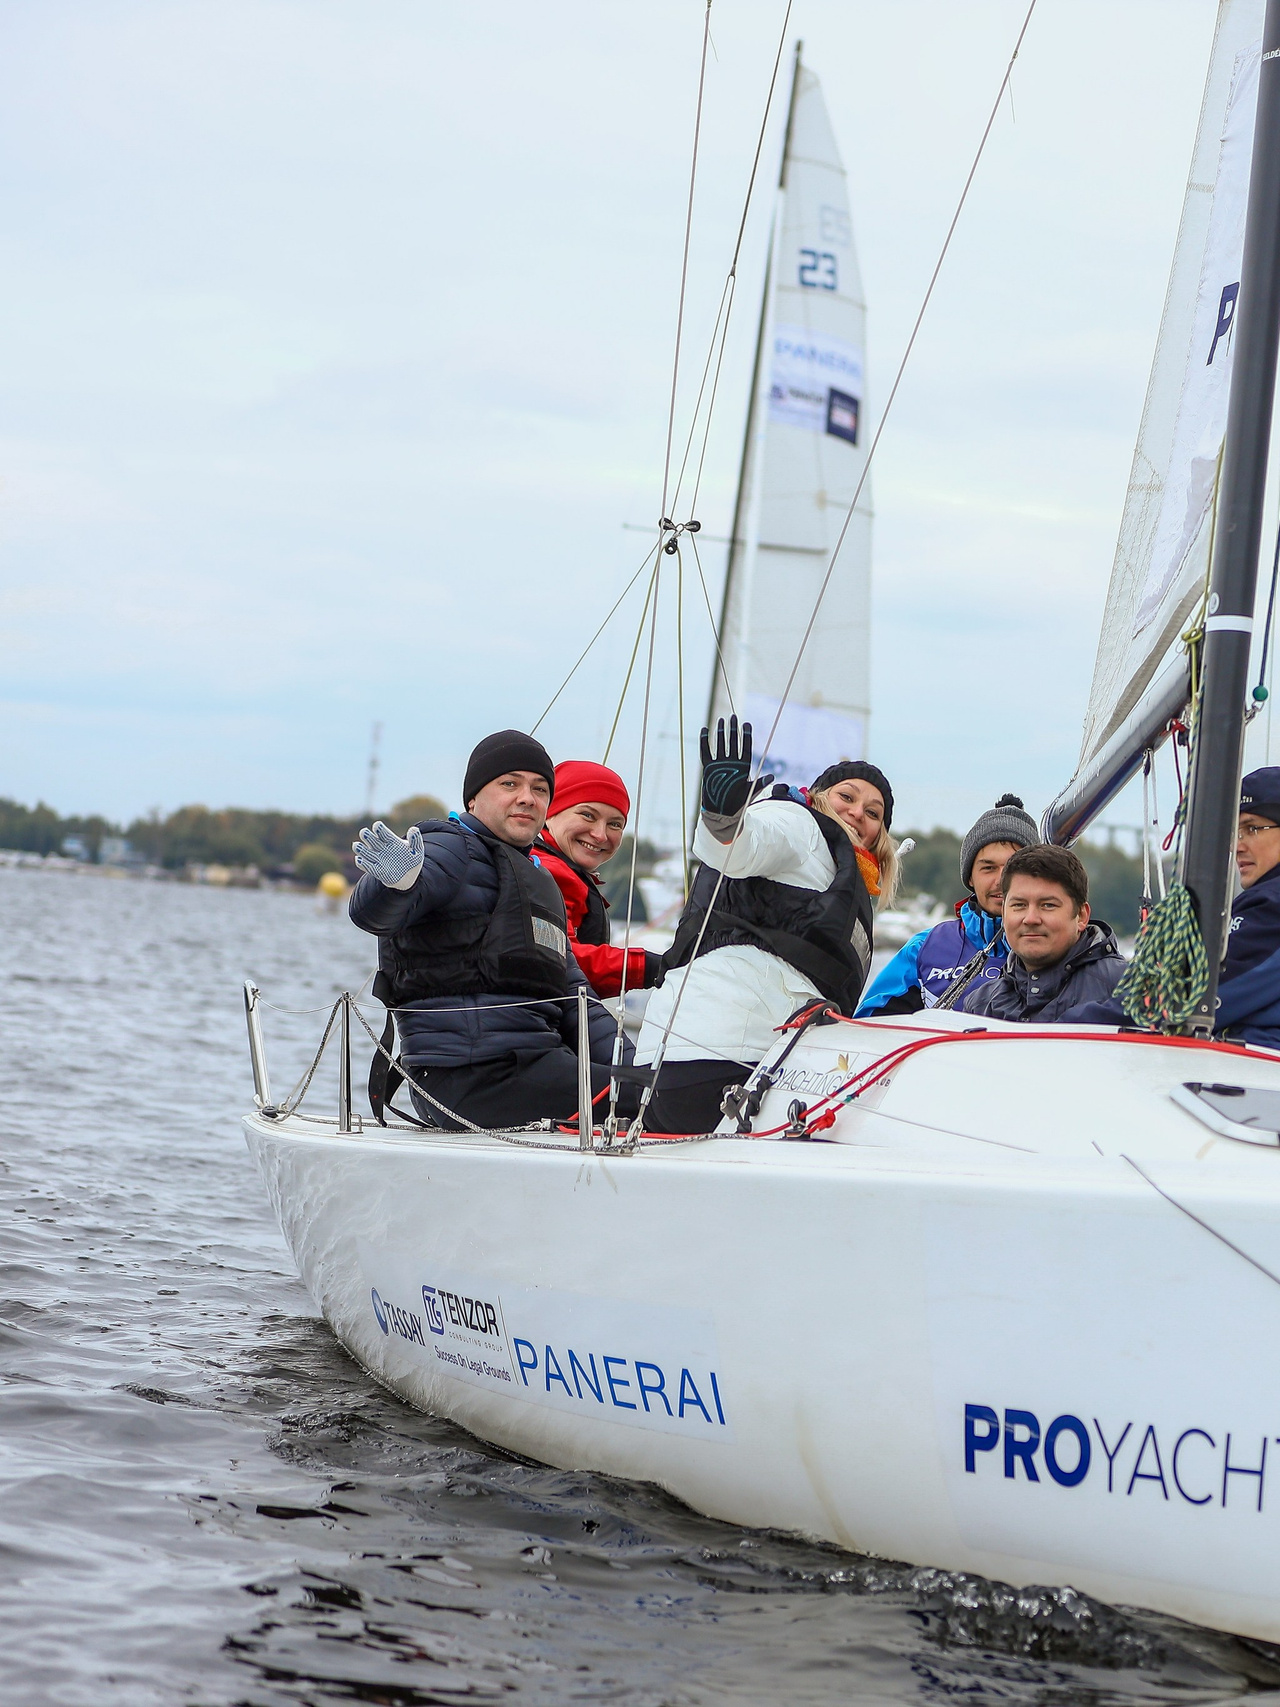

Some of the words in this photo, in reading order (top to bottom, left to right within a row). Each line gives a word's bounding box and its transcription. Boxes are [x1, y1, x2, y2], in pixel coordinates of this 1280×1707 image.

[798, 249, 838, 291] 23
[383, 1300, 426, 1347] TASSAY
[438, 1289, 500, 1337] TENZOR
[434, 1344, 460, 1366] Success
[457, 1352, 468, 1369] On
[465, 1355, 484, 1376] Legal
[482, 1361, 512, 1382] Grounds
[448, 1330, 482, 1348] CONSULTING
[484, 1341, 503, 1353] GROUP
[512, 1337, 726, 1426] PANERAI
